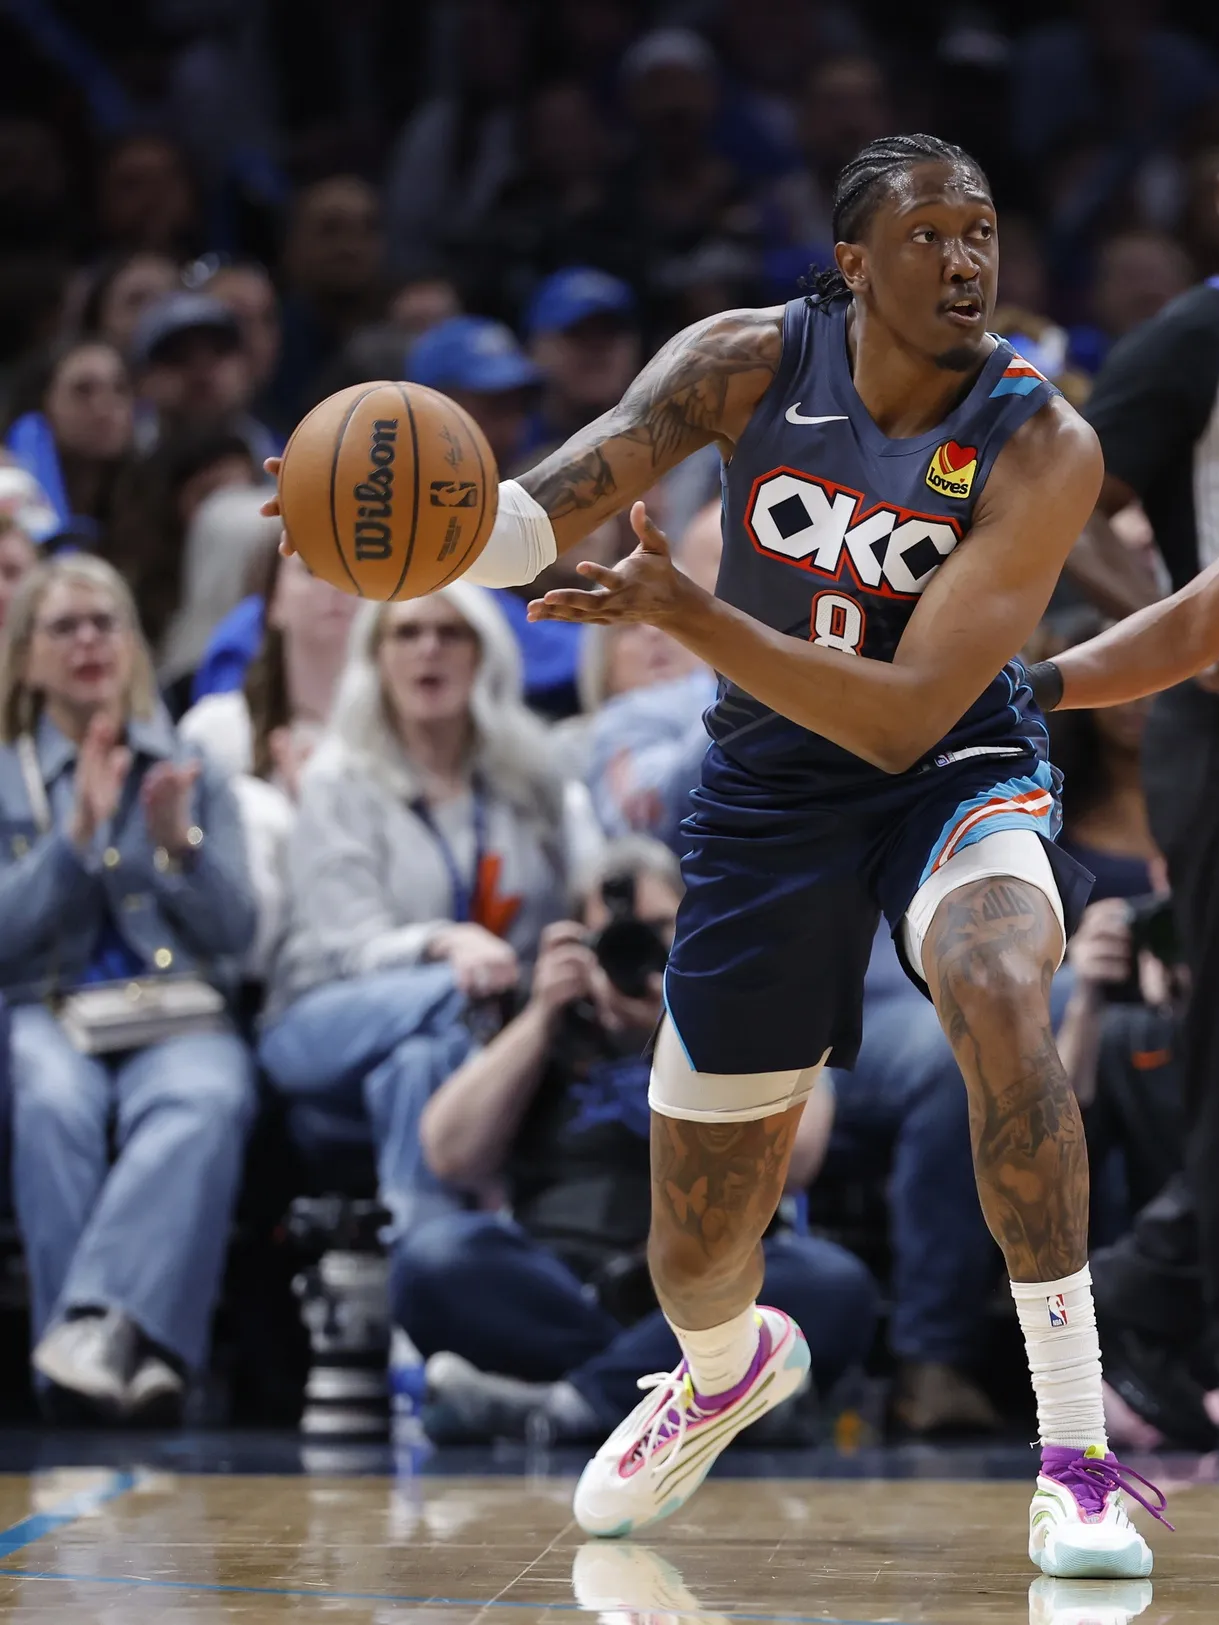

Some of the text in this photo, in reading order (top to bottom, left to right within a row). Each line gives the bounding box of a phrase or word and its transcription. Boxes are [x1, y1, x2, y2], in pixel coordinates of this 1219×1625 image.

[353, 418, 399, 561] Wilson
[748, 471, 961, 597] OKC
[812, 592, 865, 656] 8
